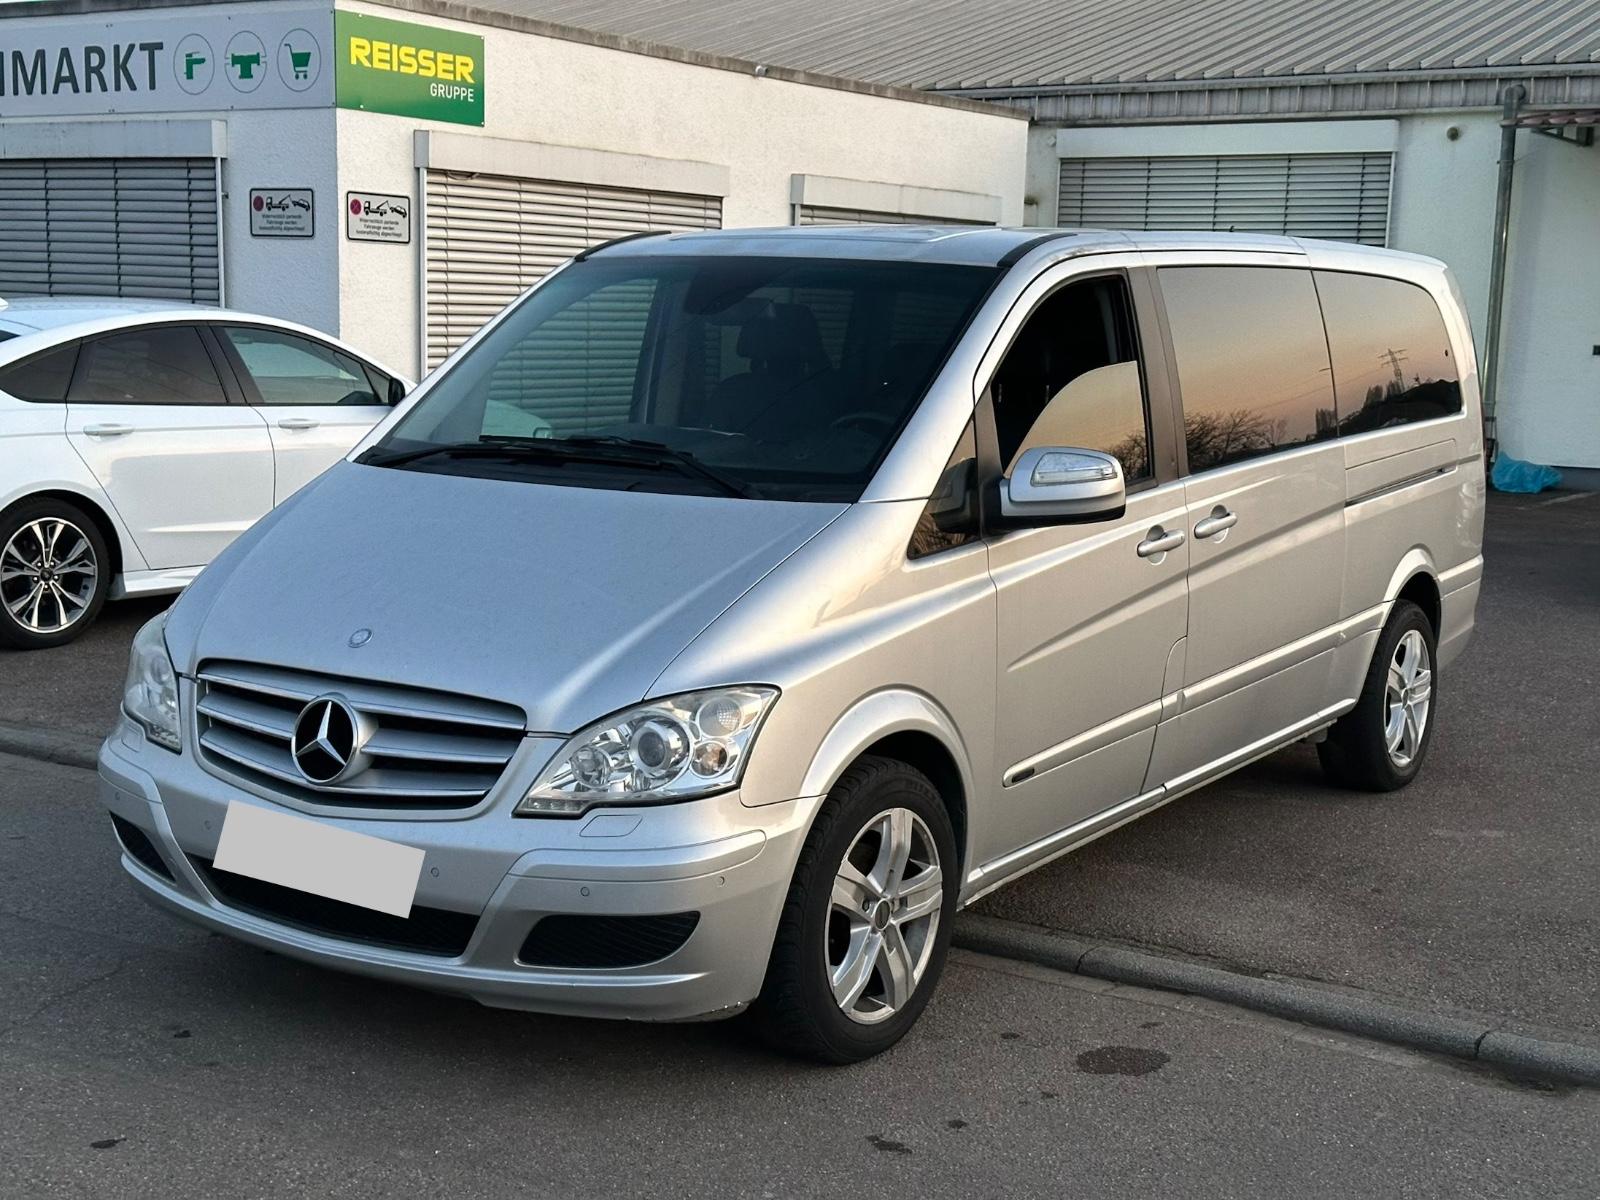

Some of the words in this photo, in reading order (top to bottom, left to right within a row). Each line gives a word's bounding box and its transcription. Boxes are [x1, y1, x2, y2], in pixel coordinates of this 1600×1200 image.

[0, 42, 164, 97] MARKT
[350, 36, 475, 83] REISSER
[430, 83, 475, 102] GRUPPE
